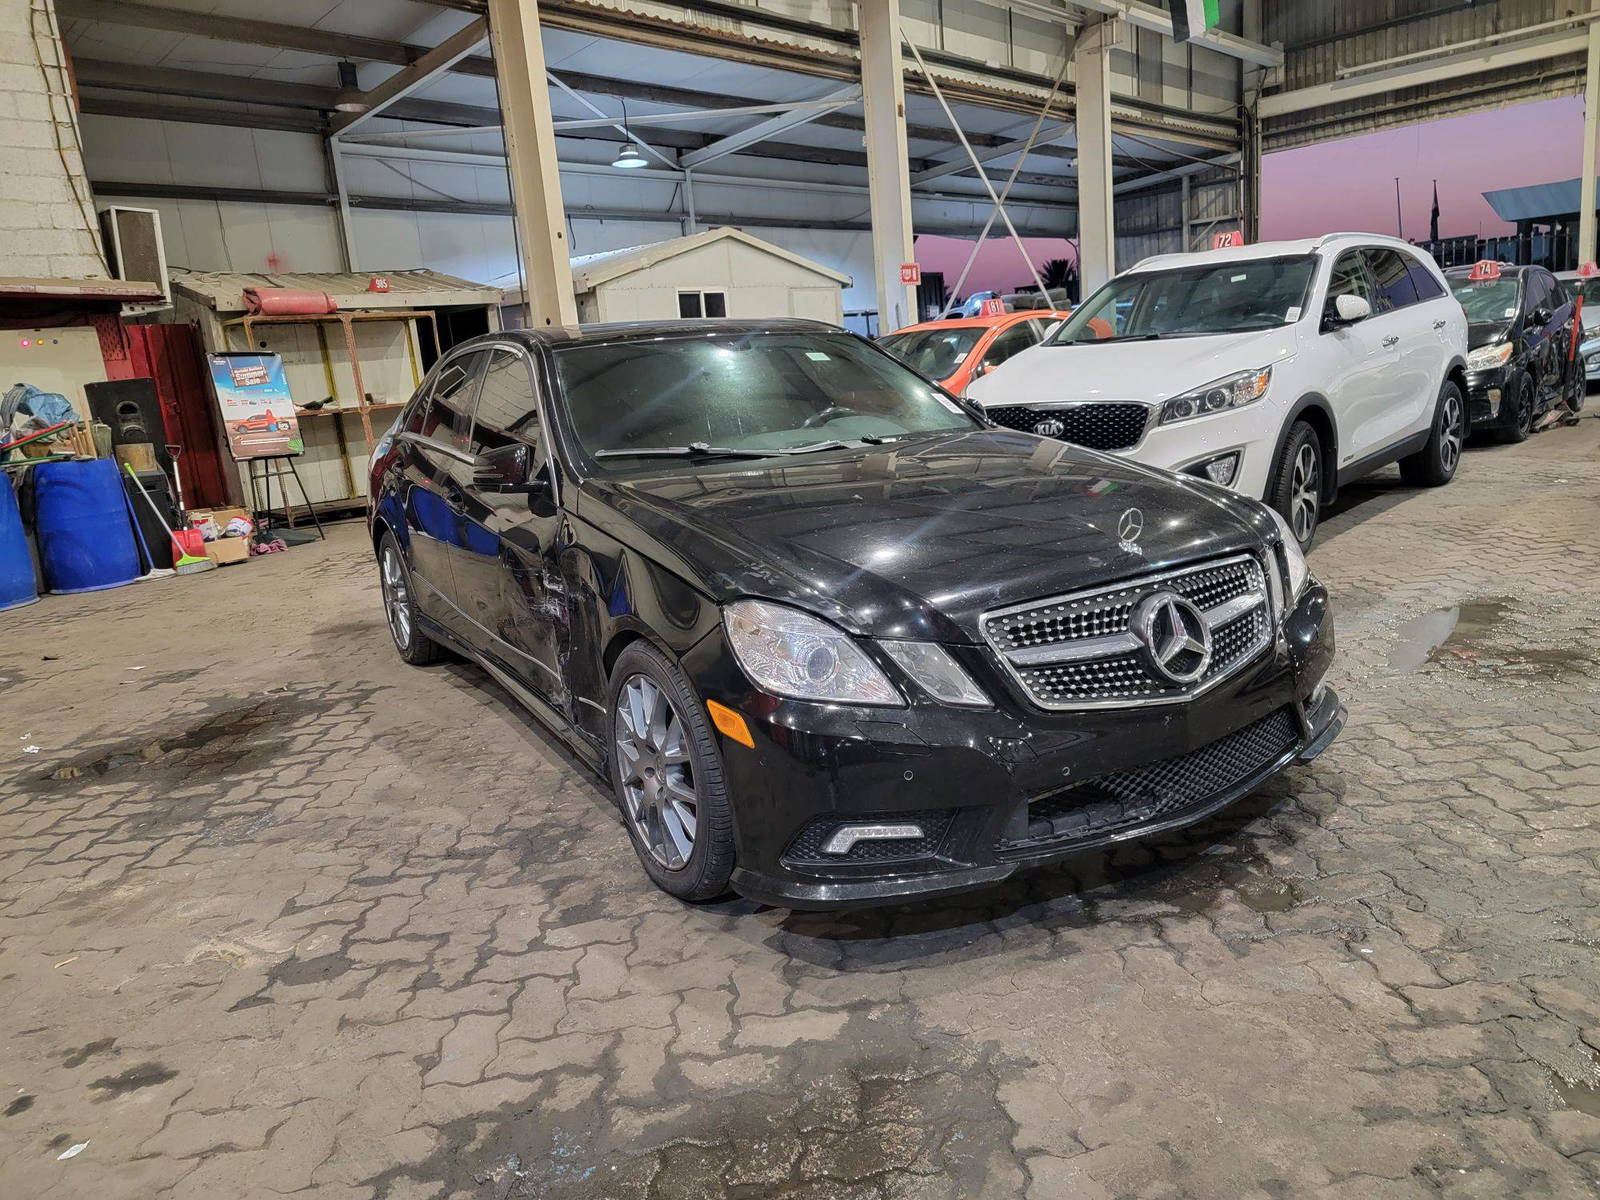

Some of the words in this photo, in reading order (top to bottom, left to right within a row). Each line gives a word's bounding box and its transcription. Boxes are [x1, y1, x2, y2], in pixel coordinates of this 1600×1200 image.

[1219, 233, 1232, 248] 72
[1480, 264, 1491, 275] 74
[1037, 424, 1058, 435] KIA
